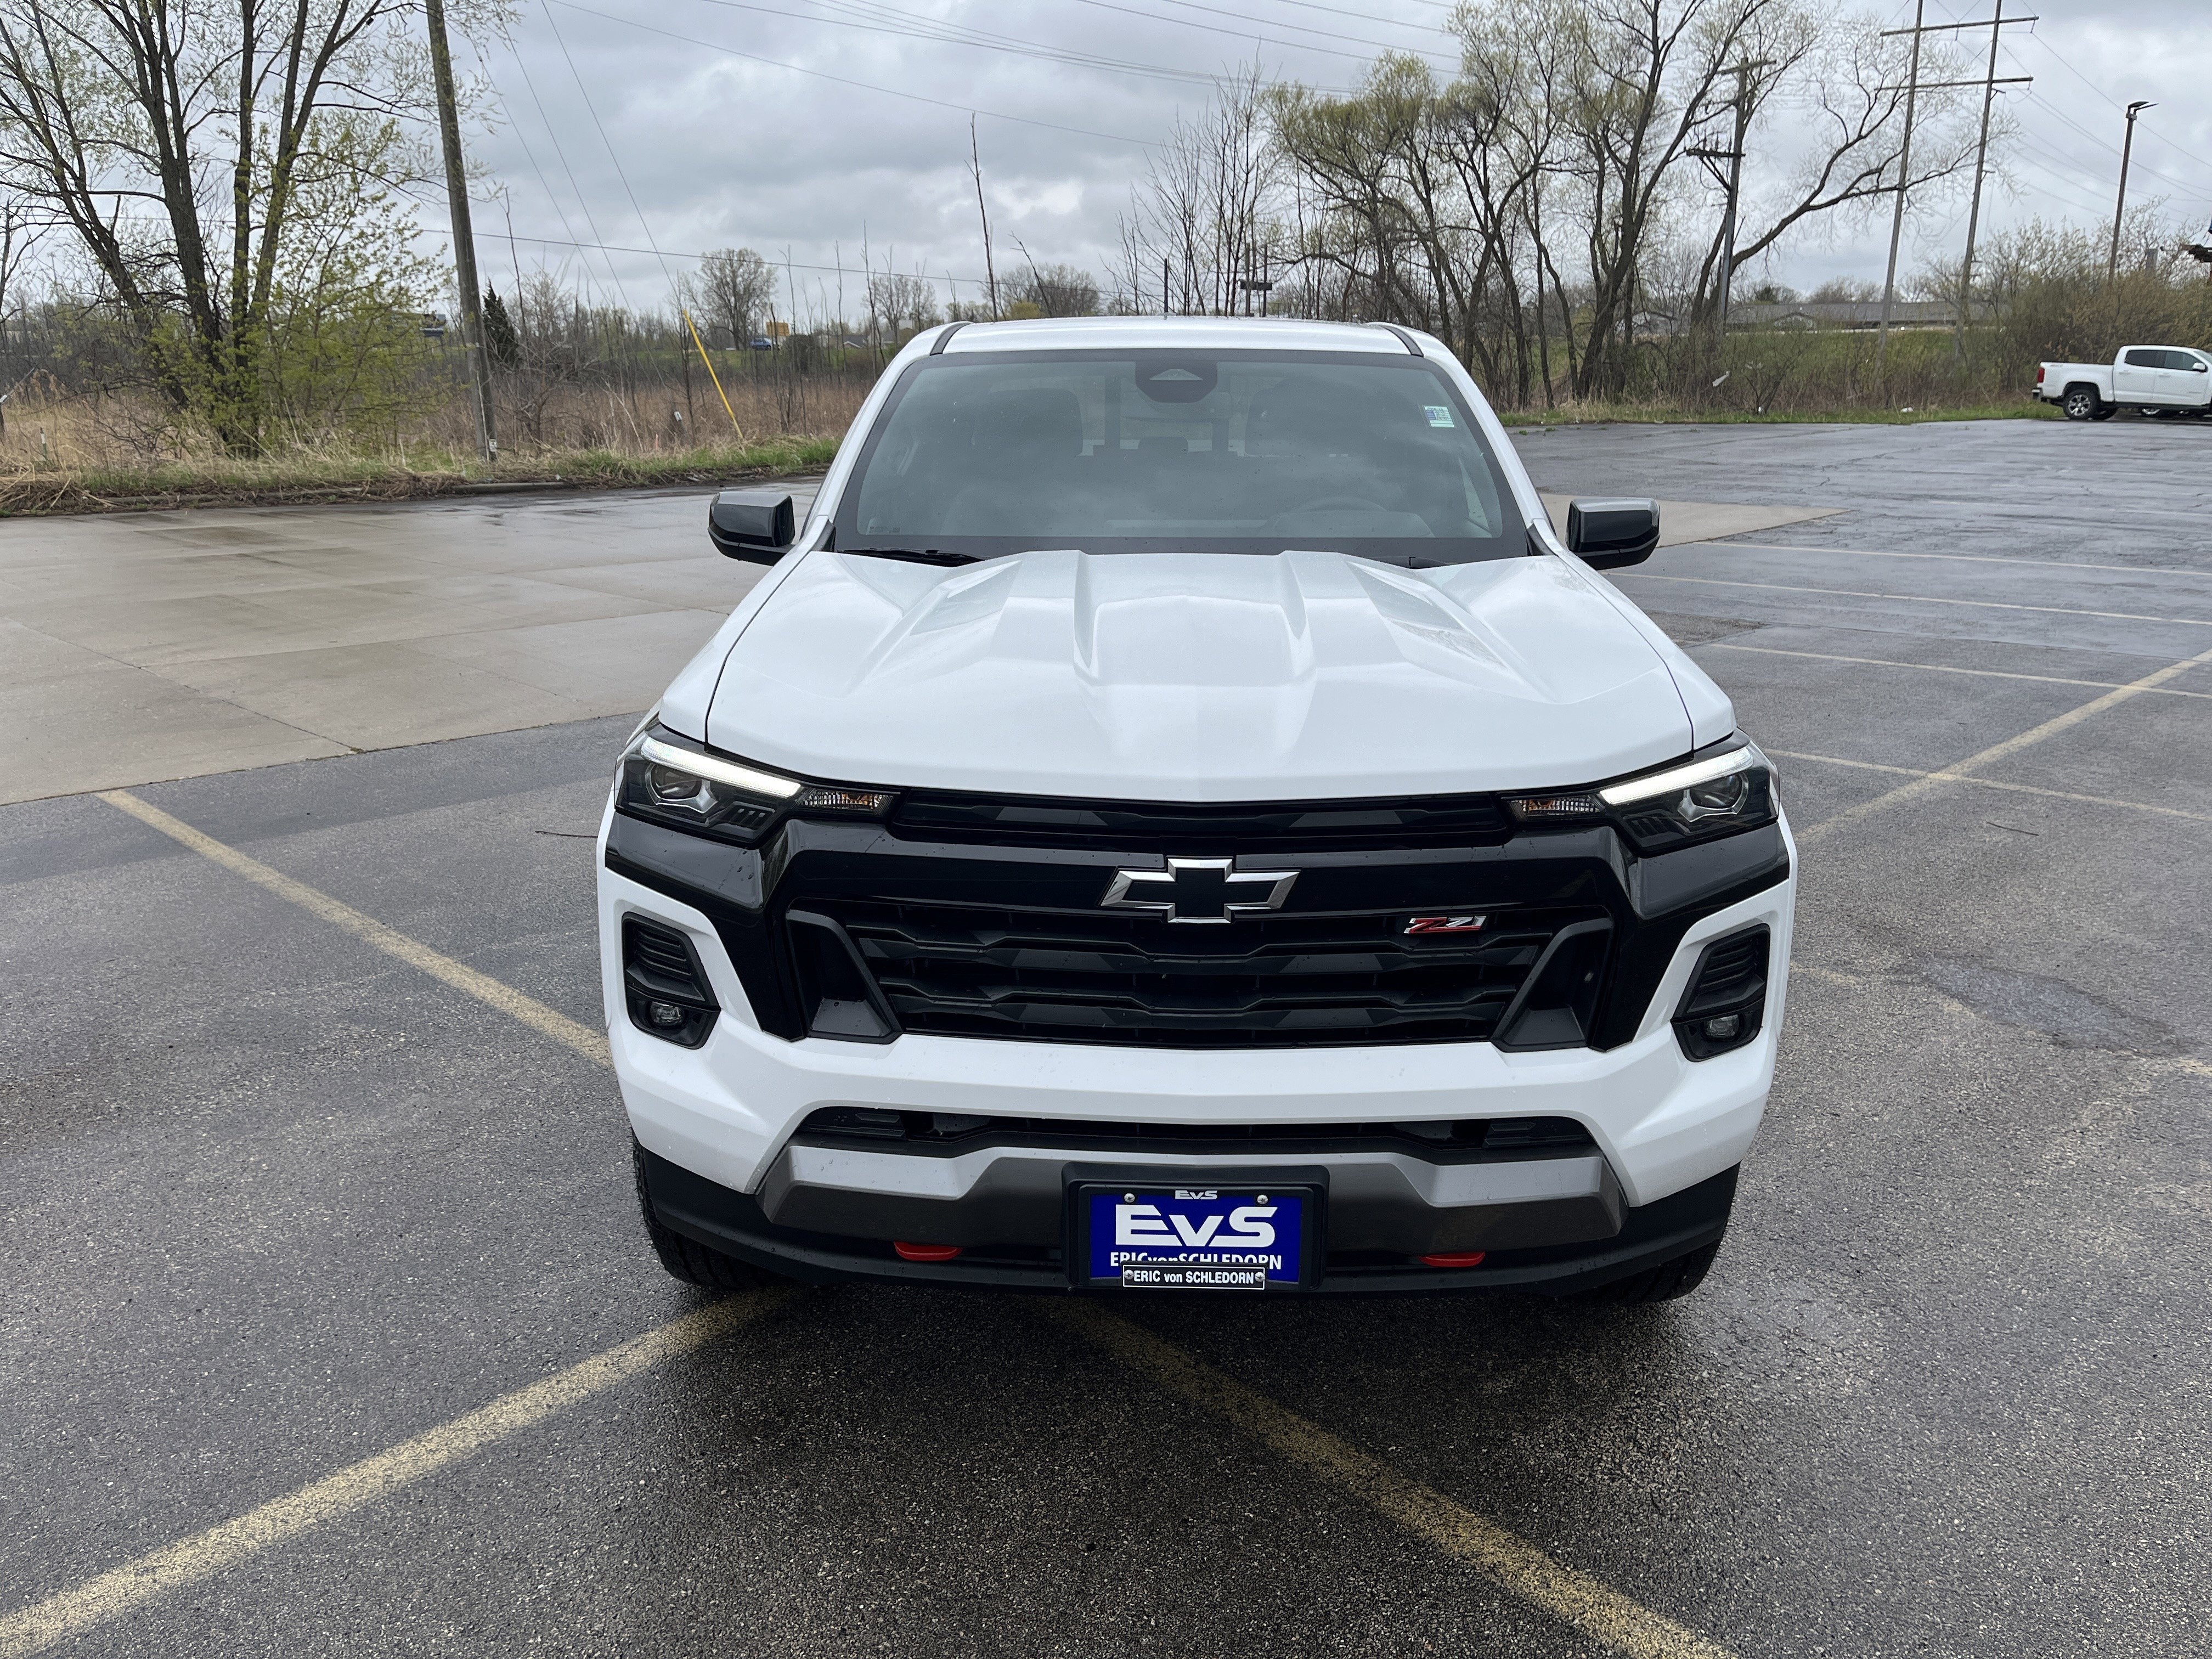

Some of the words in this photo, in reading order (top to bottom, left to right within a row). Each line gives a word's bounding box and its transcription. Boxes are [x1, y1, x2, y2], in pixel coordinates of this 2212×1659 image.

[1403, 916, 1487, 934] Z71
[1133, 1270, 1160, 1282] ERIC
[1164, 1273, 1183, 1283] von
[1186, 1271, 1254, 1284] SCHLEDORN
